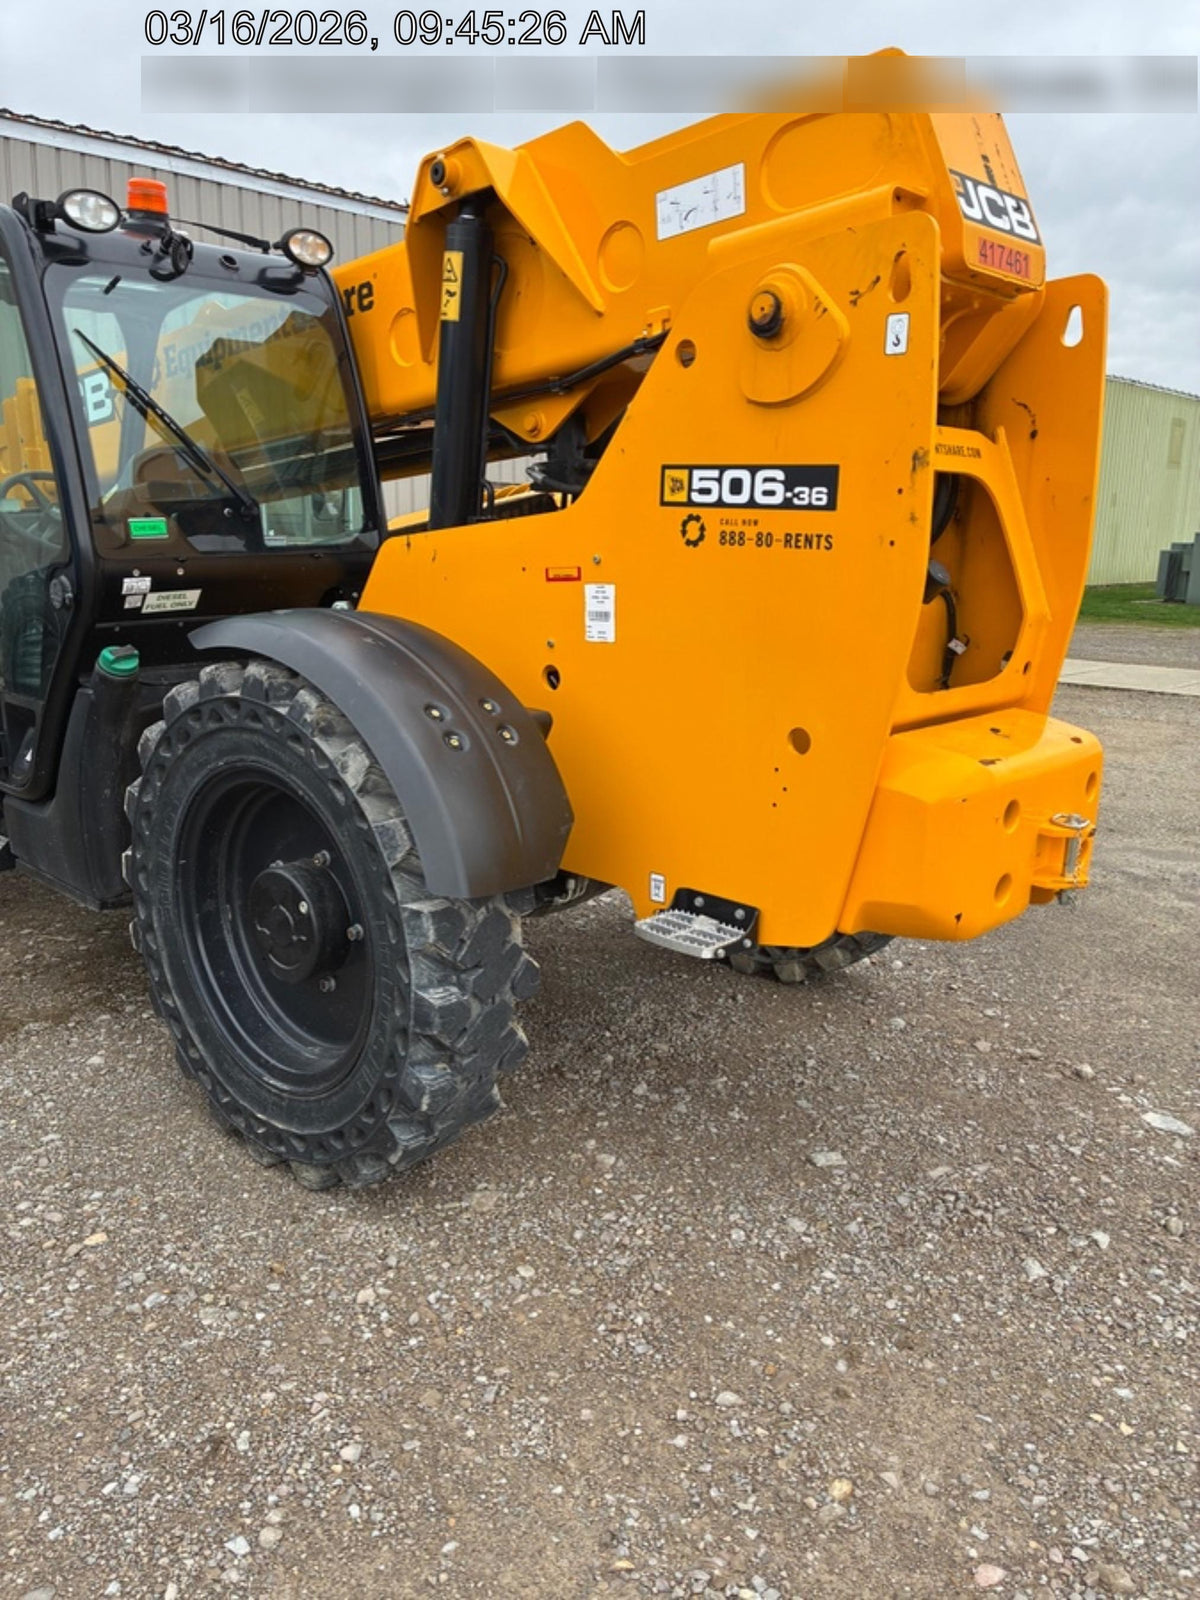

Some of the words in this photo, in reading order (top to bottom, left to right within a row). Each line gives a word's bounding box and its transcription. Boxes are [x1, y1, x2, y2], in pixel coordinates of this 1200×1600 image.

[957, 178, 1038, 240] JCB
[979, 239, 1029, 278] 417461
[690, 469, 828, 506] 506-36
[719, 518, 739, 526] CALL
[742, 519, 759, 527] NOW
[719, 530, 834, 550] 888-80-RENTS
[145, 601, 167, 610] FUEL
[170, 600, 194, 609] ONLY
[157, 593, 187, 601] DIESEL
